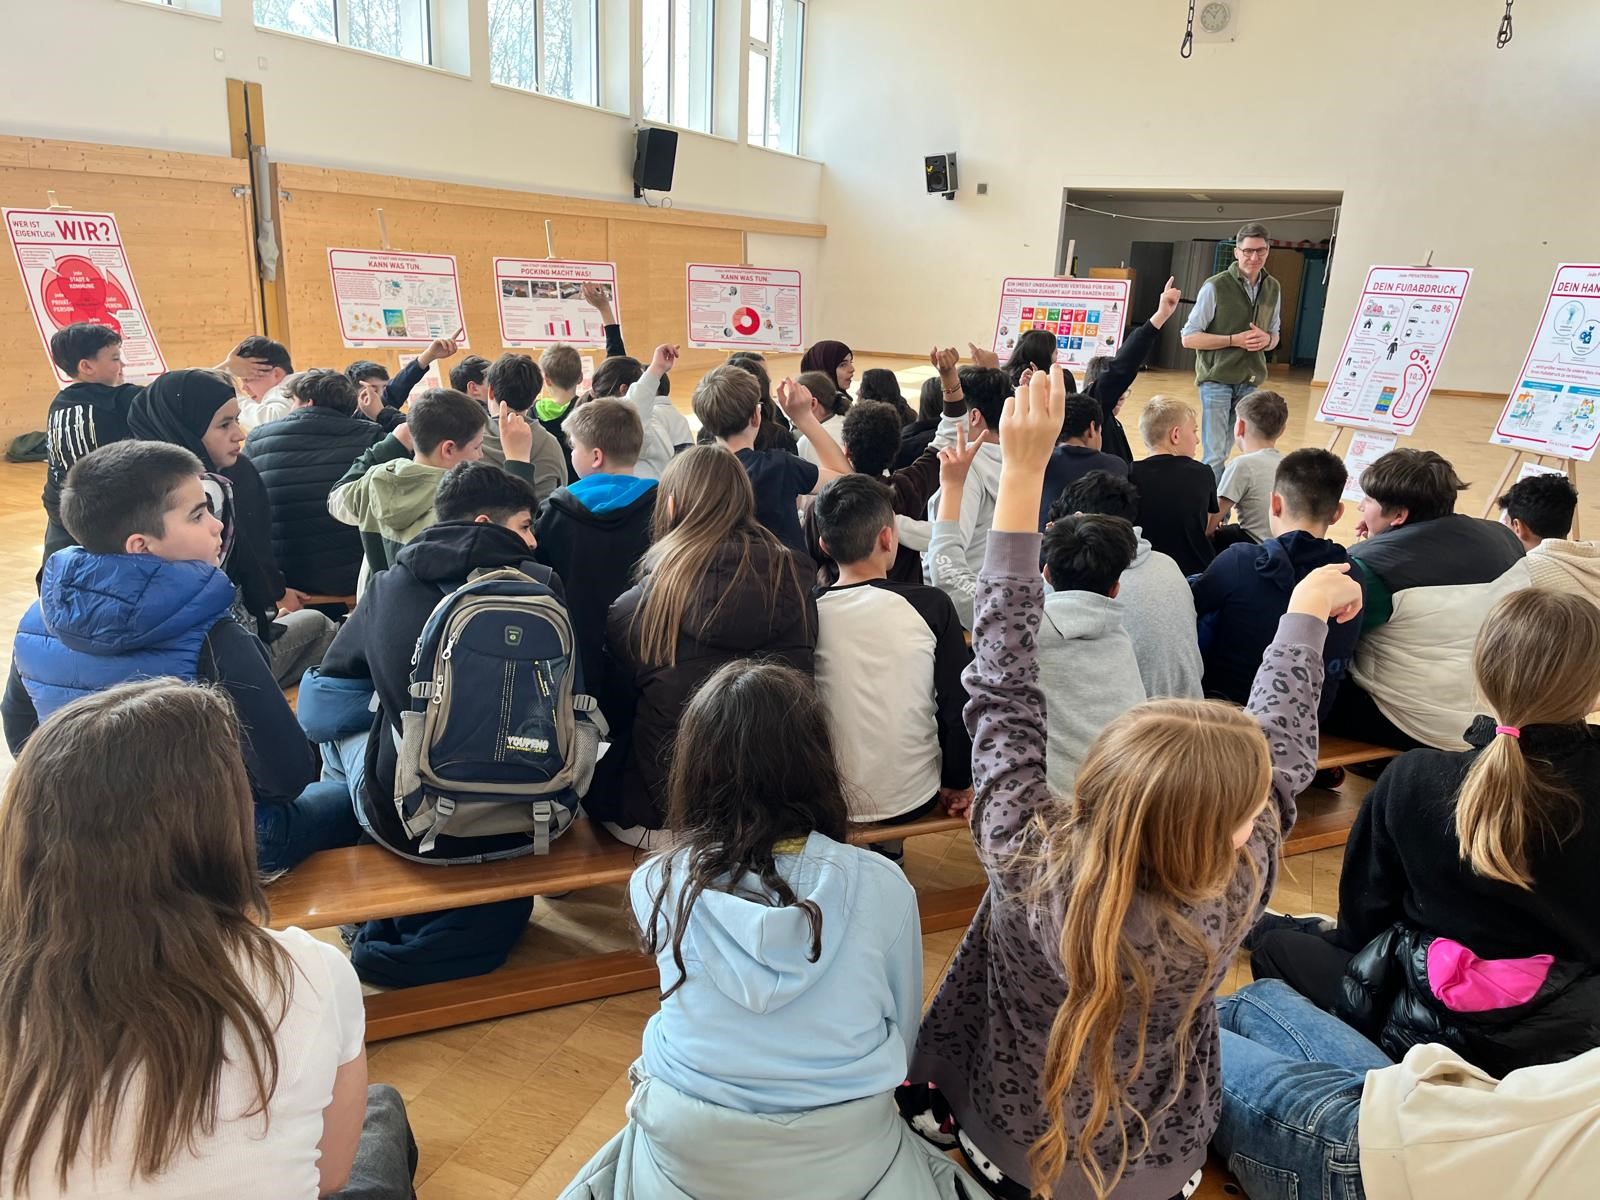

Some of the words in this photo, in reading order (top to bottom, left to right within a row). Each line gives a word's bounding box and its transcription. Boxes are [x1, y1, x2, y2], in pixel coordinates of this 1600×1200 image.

[15, 230, 55, 239] EIGENTLICH
[55, 220, 110, 241] WIR?
[368, 260, 388, 268] KANN
[1373, 282, 1394, 291] DEIN
[1557, 282, 1580, 292] DEIN
[1430, 304, 1442, 313] 88
[1408, 372, 1424, 381] 10,3
